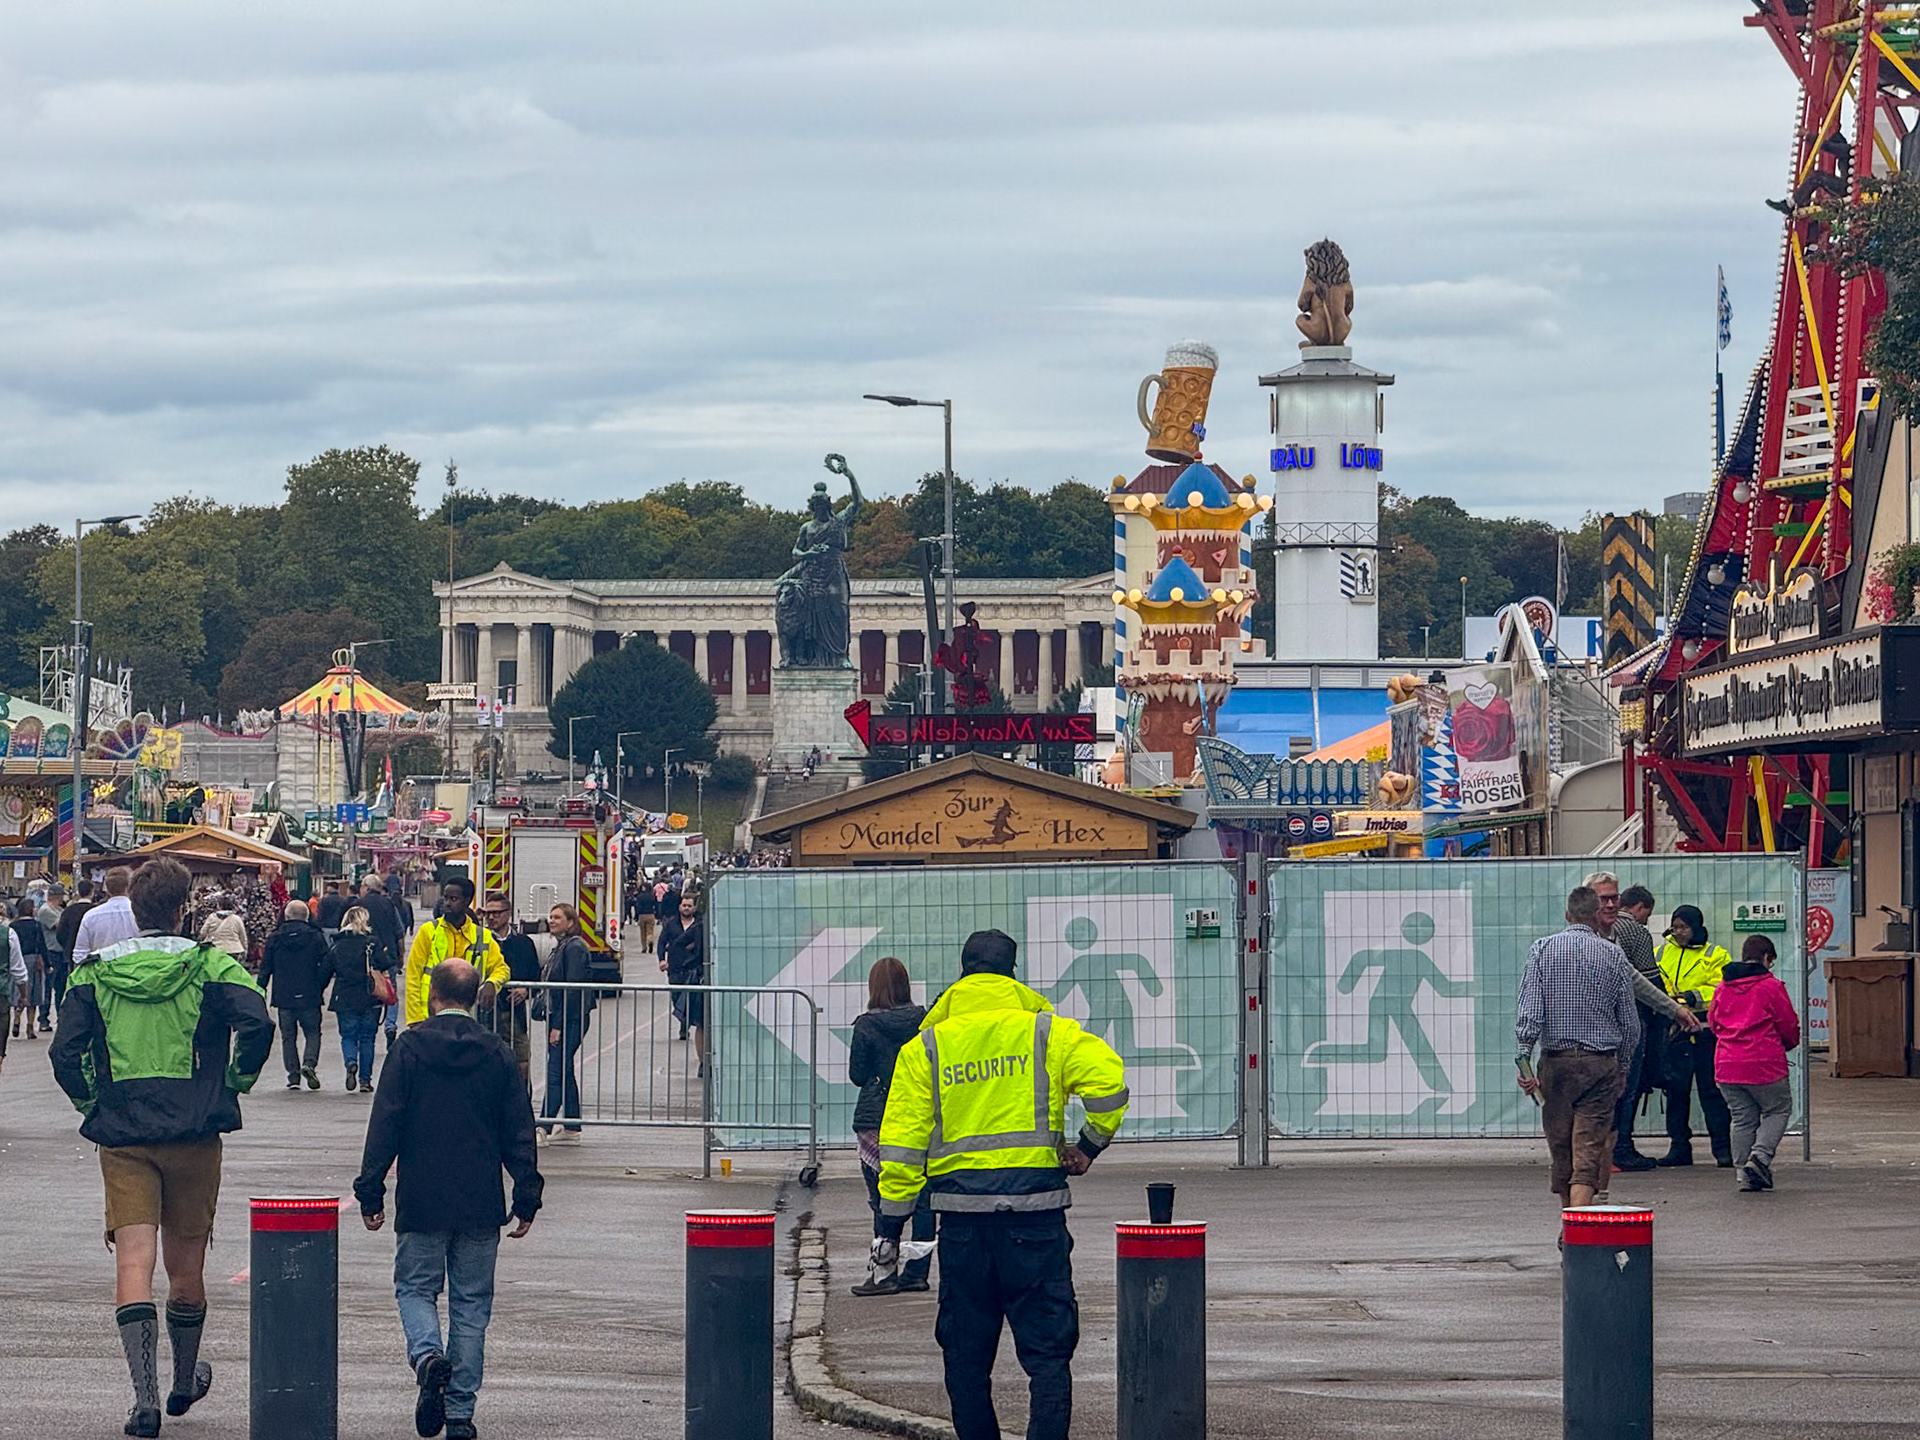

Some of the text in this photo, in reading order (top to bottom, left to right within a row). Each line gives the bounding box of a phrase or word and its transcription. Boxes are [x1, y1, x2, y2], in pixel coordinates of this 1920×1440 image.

[1340, 443, 1383, 471] LÖW
[1461, 772, 1519, 788] FAIRTRADE
[945, 789, 994, 818] Zur
[1462, 784, 1522, 804] ROSEN
[840, 819, 1105, 850] Mandel Hex
[1364, 817, 1408, 831] Imbiss
[1752, 904, 1780, 914] Eisl
[943, 1054, 1029, 1087] SECURITY
